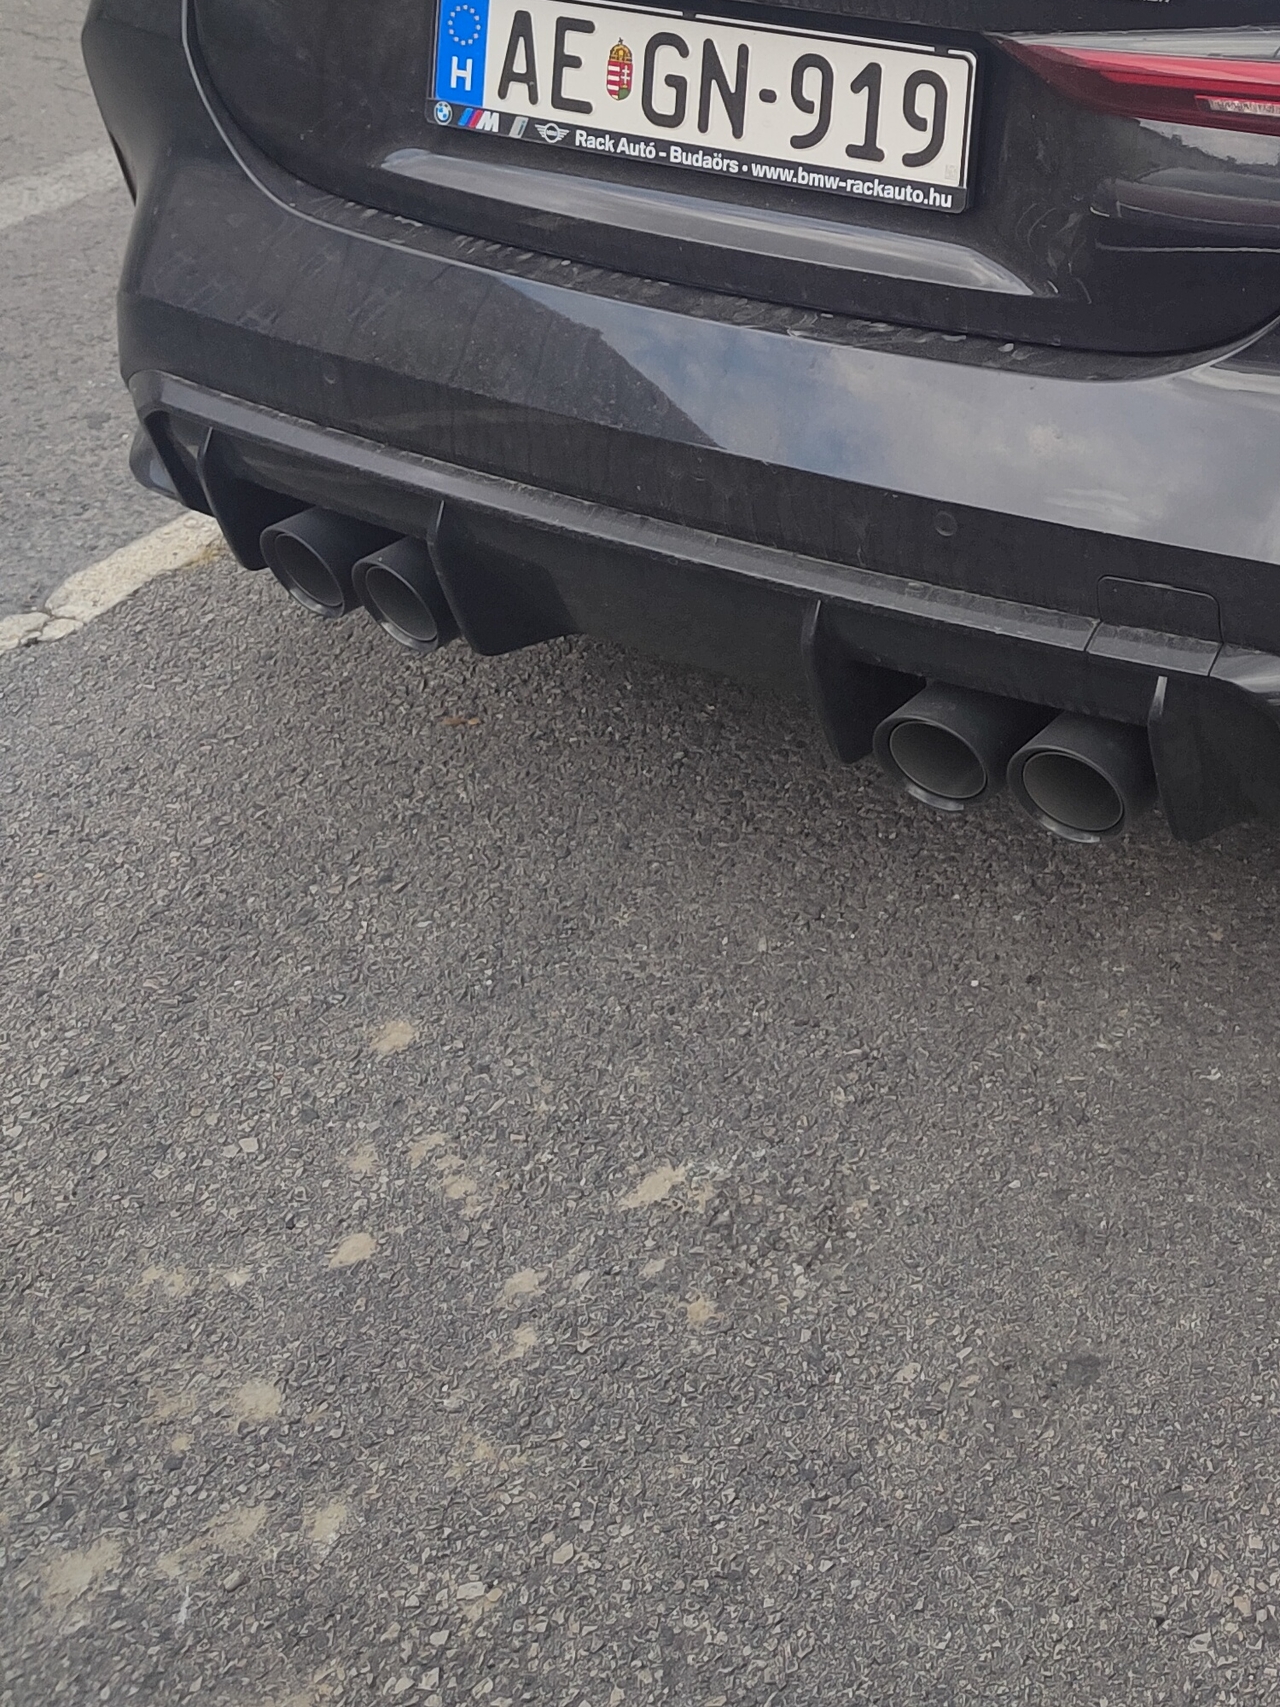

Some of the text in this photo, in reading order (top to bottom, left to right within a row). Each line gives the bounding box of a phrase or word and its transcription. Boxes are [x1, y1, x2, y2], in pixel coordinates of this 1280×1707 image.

[450, 56, 474, 92] H
[497, 9, 949, 169] AE GN-919
[575, 129, 615, 153] Rack
[616, 137, 656, 159] Autó
[669, 145, 739, 174] Budaörs
[751, 162, 953, 209] www.bmw-rackauto.hu
